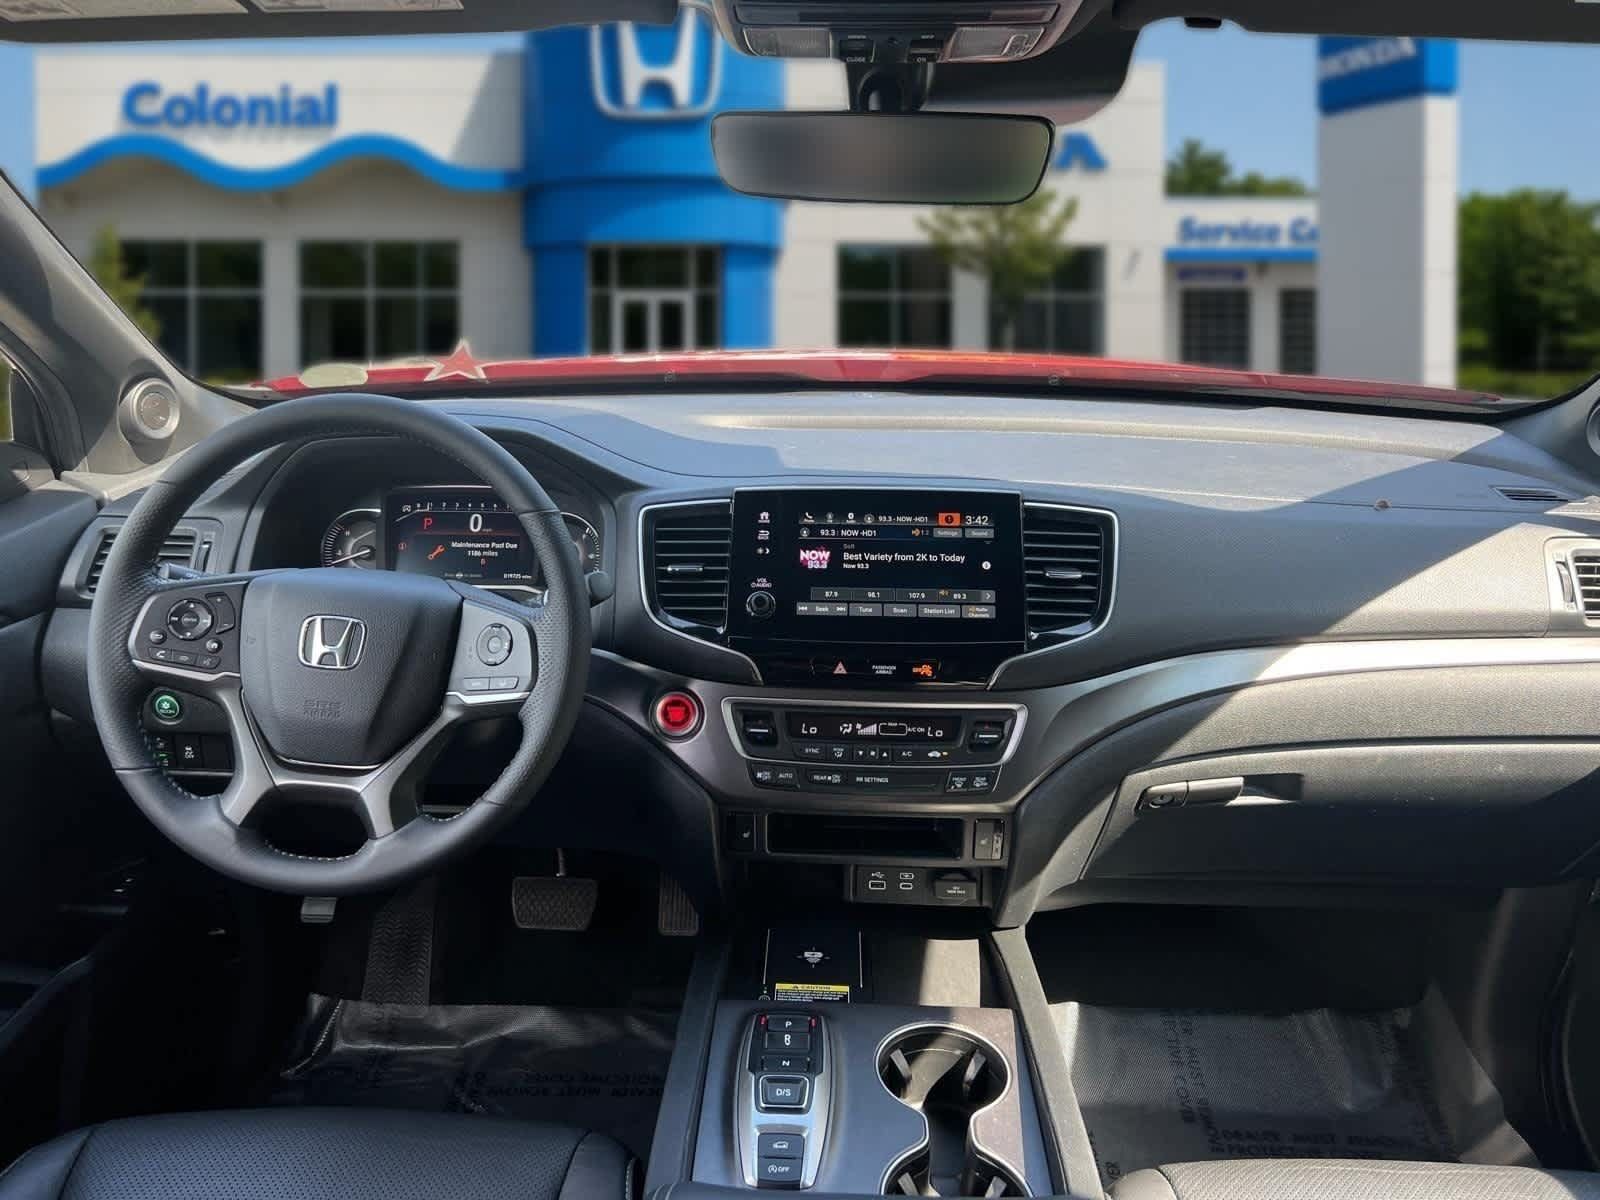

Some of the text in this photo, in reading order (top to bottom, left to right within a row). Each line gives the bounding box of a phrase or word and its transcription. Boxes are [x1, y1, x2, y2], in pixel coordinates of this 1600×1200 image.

[122, 81, 338, 128] Colonial
[1180, 216, 1280, 242] Service
[423, 517, 433, 530] P
[469, 513, 483, 532] 0
[965, 515, 989, 525] 3:42
[451, 541, 490, 549] Maintenance
[491, 542, 504, 550] Past
[799, 549, 830, 560] NOW
[843, 552, 863, 561] Best
[864, 552, 892, 563] Variety
[894, 552, 914, 561] from
[915, 553, 928, 561] 2K
[940, 553, 965, 564] Today
[807, 560, 828, 569] 93.3
[801, 723, 817, 734] Lo
[927, 726, 943, 737] Lo
[785, 1020, 792, 1028] P
[776, 1088, 791, 1096] D/S
